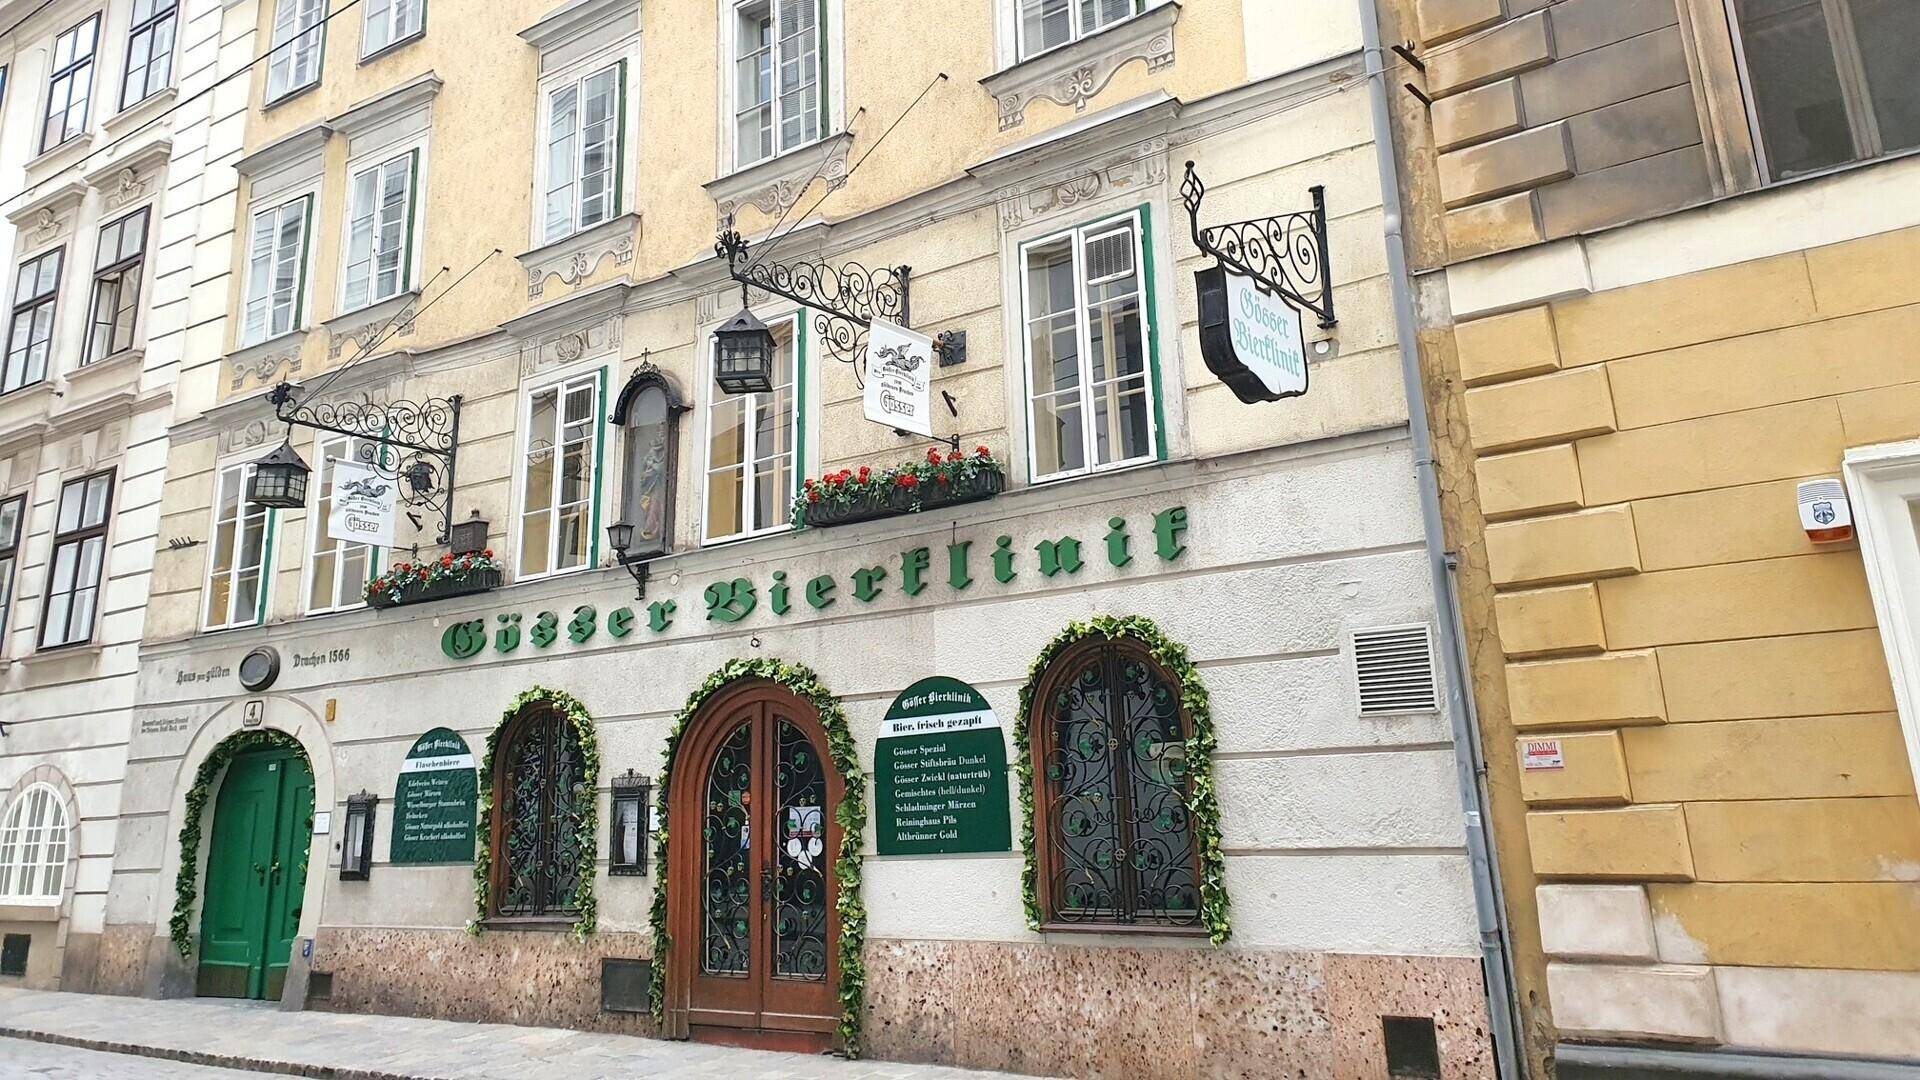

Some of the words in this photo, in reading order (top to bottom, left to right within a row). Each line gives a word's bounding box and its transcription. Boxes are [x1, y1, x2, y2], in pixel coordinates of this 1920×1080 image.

[1233, 318, 1300, 377] Bierklinik
[441, 599, 678, 659] Gösser
[704, 505, 1187, 623] Bierklinik
[293, 652, 326, 668] Drachen
[329, 649, 350, 664] 1566
[928, 691, 972, 705] Bierklinik
[249, 703, 256, 718] 4
[917, 718, 944, 730] frisch
[947, 715, 982, 729] gezapft
[893, 747, 918, 757] Gösser
[919, 744, 946, 756] Spezial
[1527, 741, 1557, 752] DIMMI
[415, 759, 460, 769] Flaschenbiere
[893, 761, 918, 770] Gösser
[920, 756, 957, 769] Stiftsbräu
[958, 754, 986, 765] Dunkel
[894, 774, 919, 784] Gösser
[921, 772, 946, 783] Zwickl
[947, 770, 991, 782] (naturtrüb)
[895, 788, 936, 798] Gemischtes
[938, 784, 986, 797] (hell/dunkel)
[895, 801, 946, 812] Schladminger
[948, 800, 976, 810] Märzen
[896, 817, 941, 828] Reininghaus
[942, 815, 957, 825] Pils
[896, 831, 937, 841] Altbrünner
[939, 829, 958, 840] Gold
